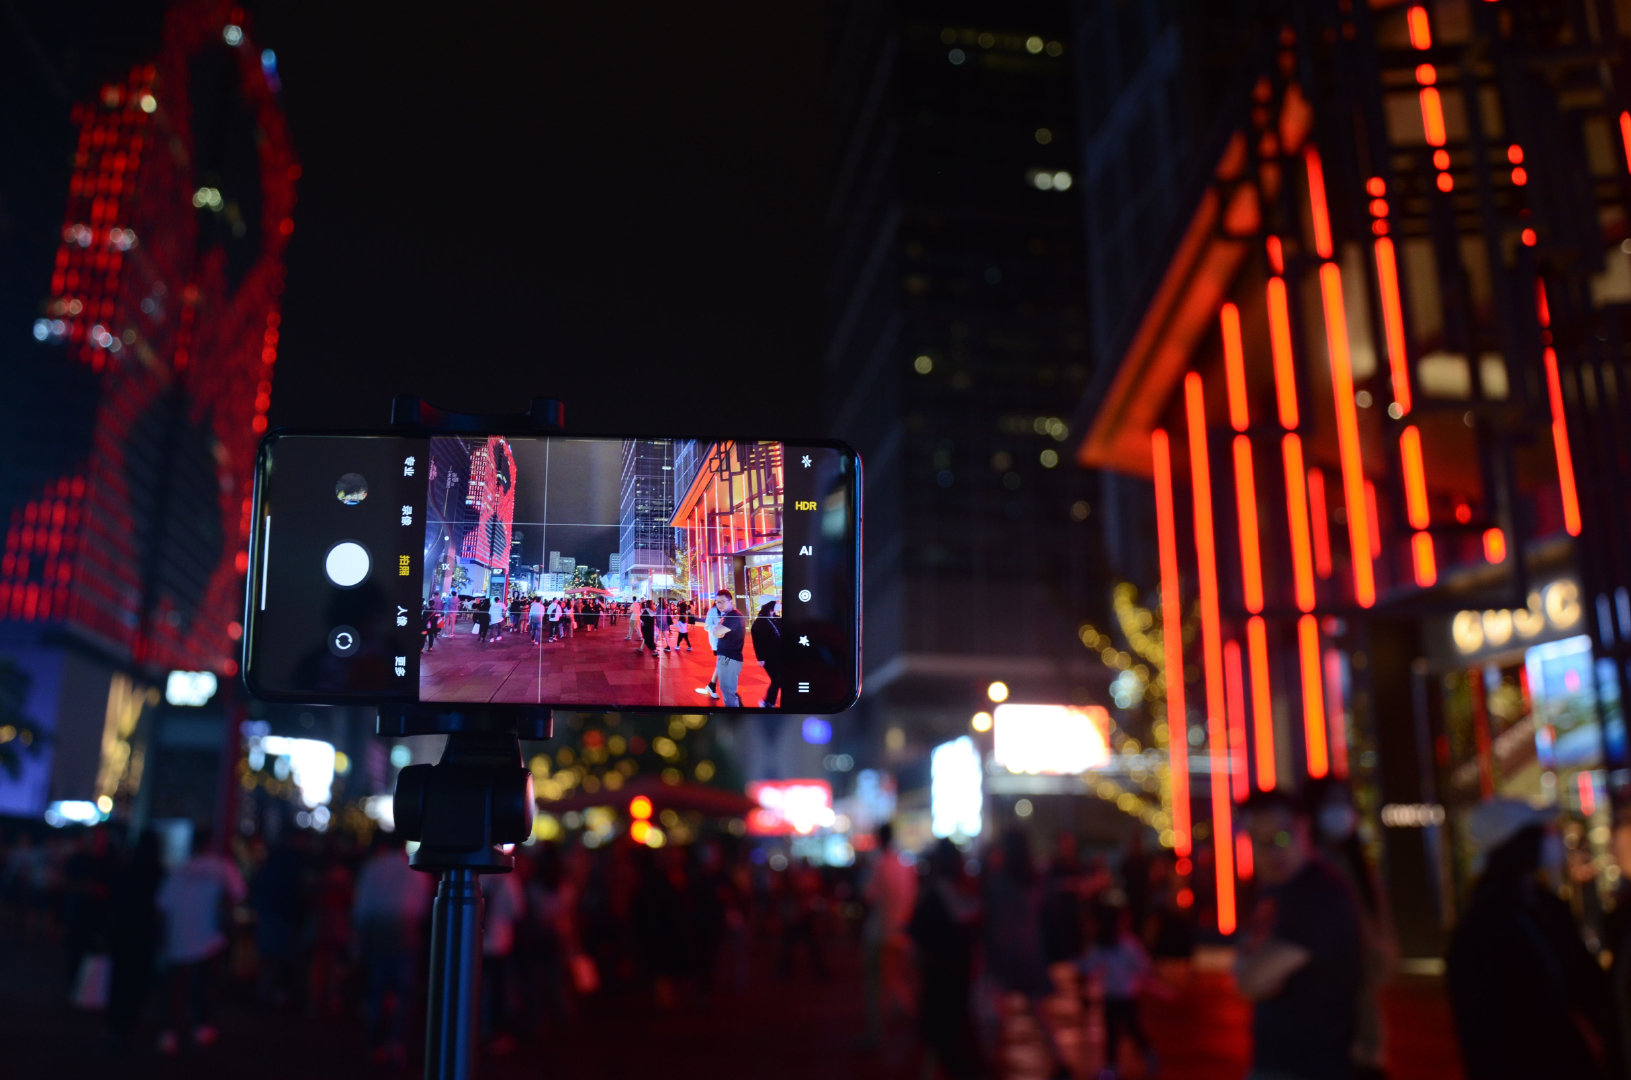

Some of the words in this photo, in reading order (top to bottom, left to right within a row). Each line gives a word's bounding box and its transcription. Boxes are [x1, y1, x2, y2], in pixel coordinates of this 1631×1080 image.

[404, 456, 416, 476] 专业
[401, 505, 413, 526] 录像
[795, 501, 817, 511] HDR
[799, 545, 813, 556] AI
[399, 555, 410, 576] 拍照
[441, 563, 450, 571] 1X
[396, 605, 408, 627] 人像
[394, 656, 406, 677] 更多
